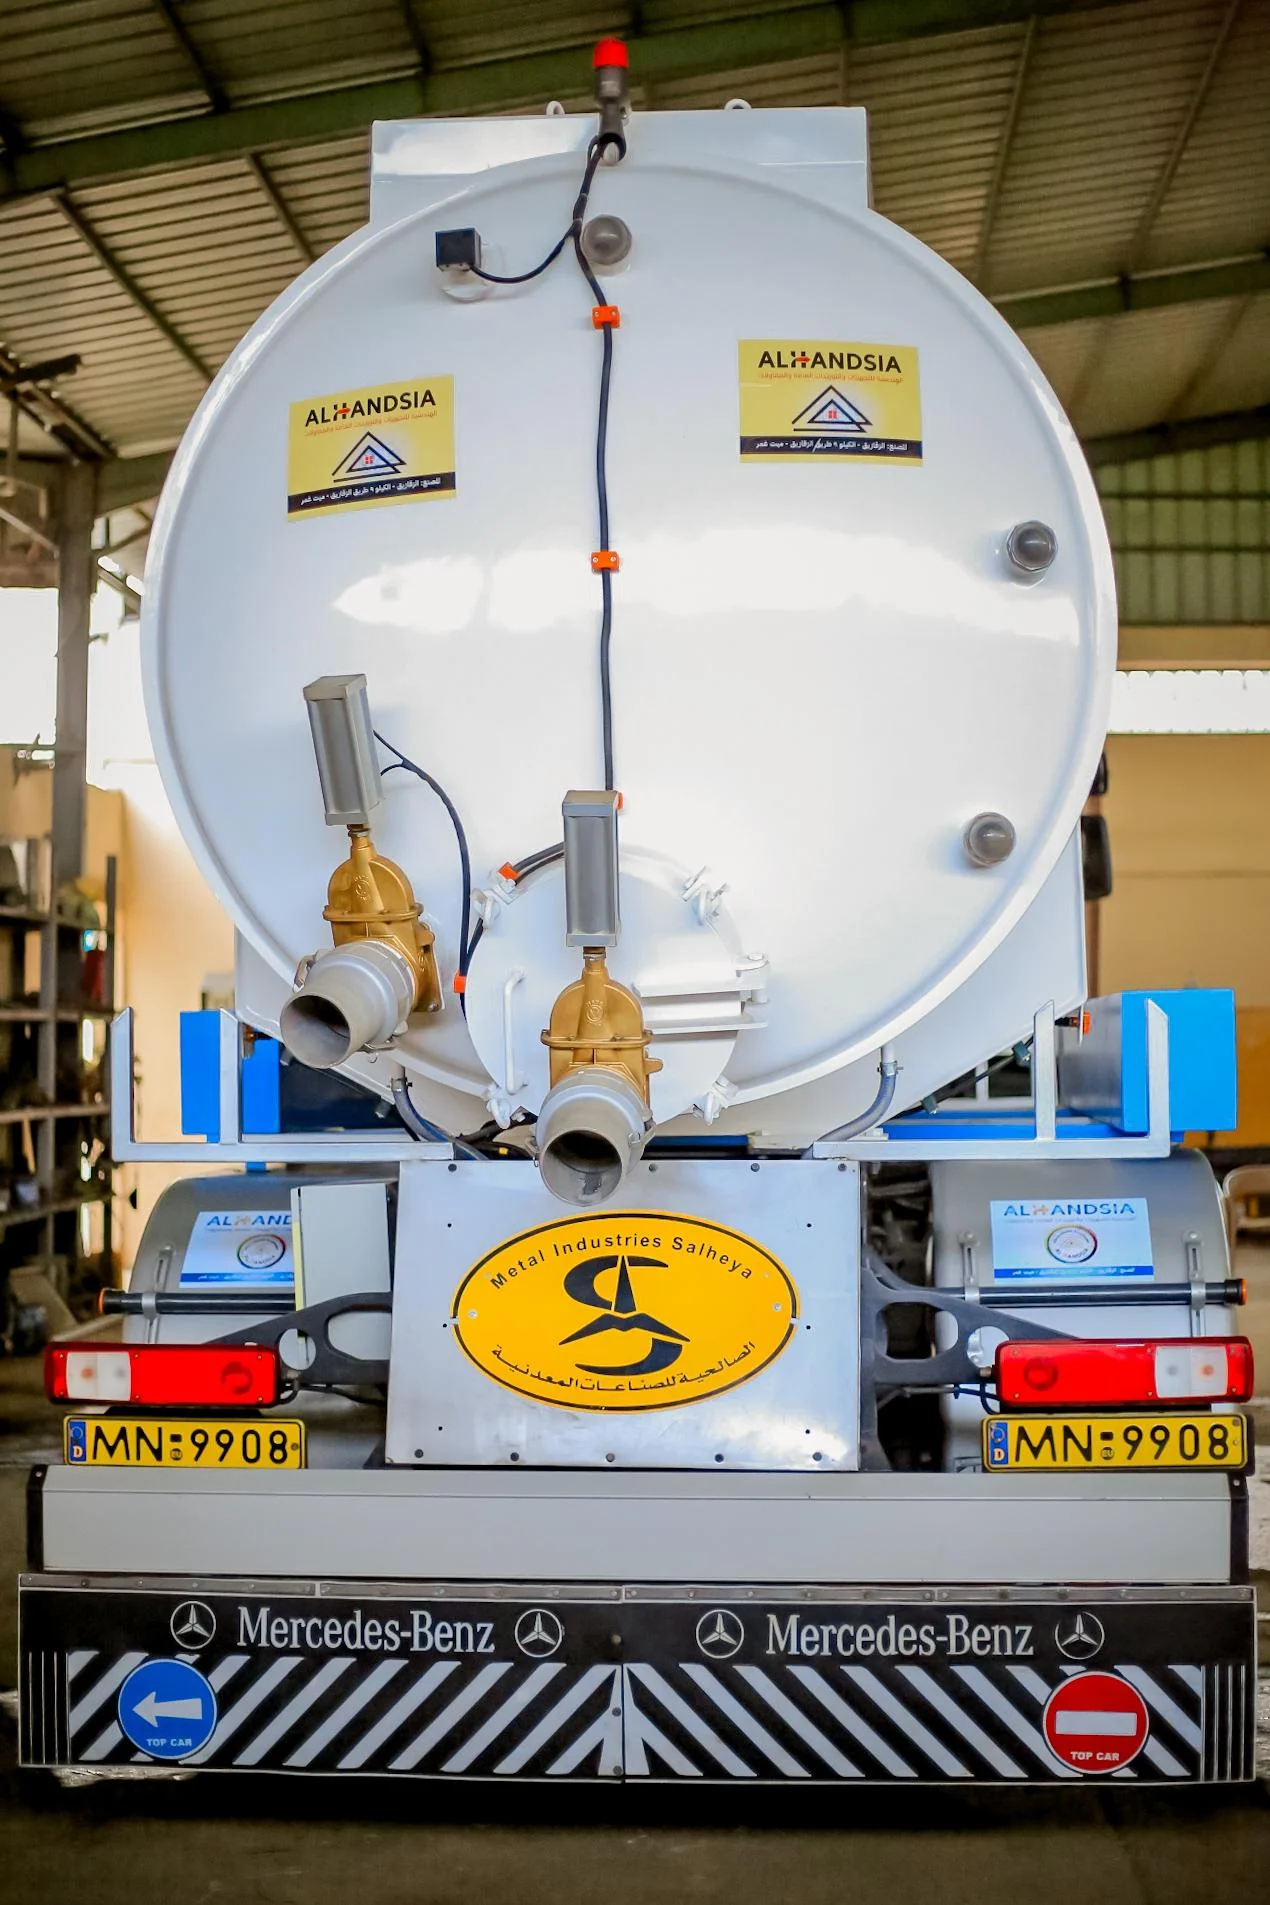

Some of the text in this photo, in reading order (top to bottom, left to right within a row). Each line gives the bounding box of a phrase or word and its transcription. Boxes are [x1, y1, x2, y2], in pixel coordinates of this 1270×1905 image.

[758, 350, 902, 373] ALHANDSIA
[305, 389, 436, 427] ALHANDSIA
[1003, 1203, 1135, 1216] ALHANDSIA
[489, 1232, 753, 1290] Metal Industries Salheya
[491, 1340, 756, 1393] الصالحية للصناعات المعدنية
[72, 1446, 83, 1459] D
[92, 1425, 288, 1464] MN 9908
[993, 1447, 1004, 1461] D
[1015, 1423, 1229, 1462] MN 9908
[237, 1606, 496, 1654] Mercedes-Benz
[765, 1613, 1034, 1657] Mercedes-Benz
[146, 1738, 193, 1748] TOP CAR
[1070, 1751, 1120, 1762] TOP CAR
